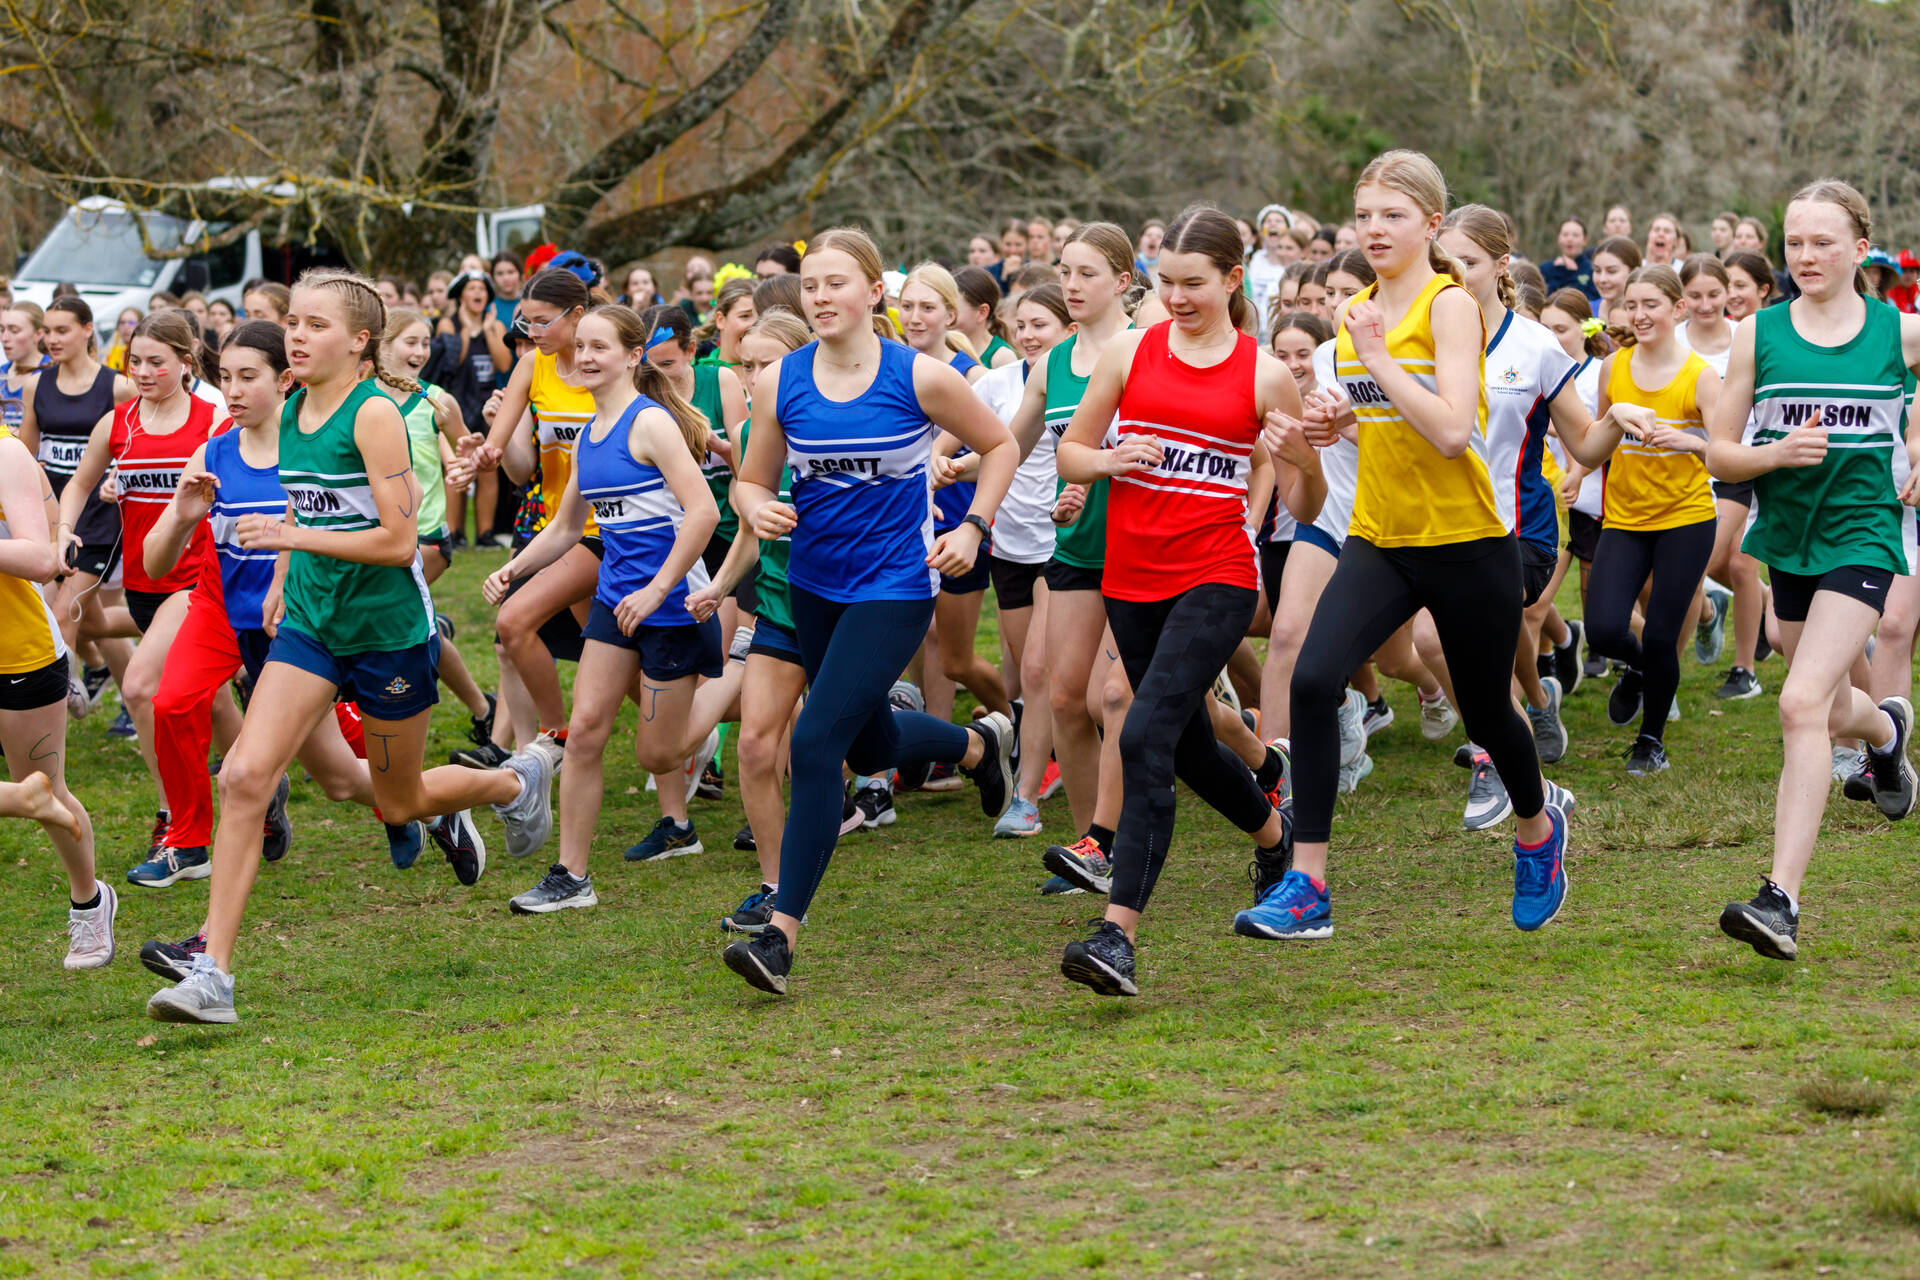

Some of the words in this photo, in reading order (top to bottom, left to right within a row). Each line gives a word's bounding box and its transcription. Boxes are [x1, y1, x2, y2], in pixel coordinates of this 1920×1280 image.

[1781, 403, 1872, 427] WILSON
[554, 426, 581, 441] RO
[52, 446, 87, 462] BLAK
[808, 457, 882, 476] SCOTT
[643, 683, 672, 722] J
[370, 732, 400, 772] J
